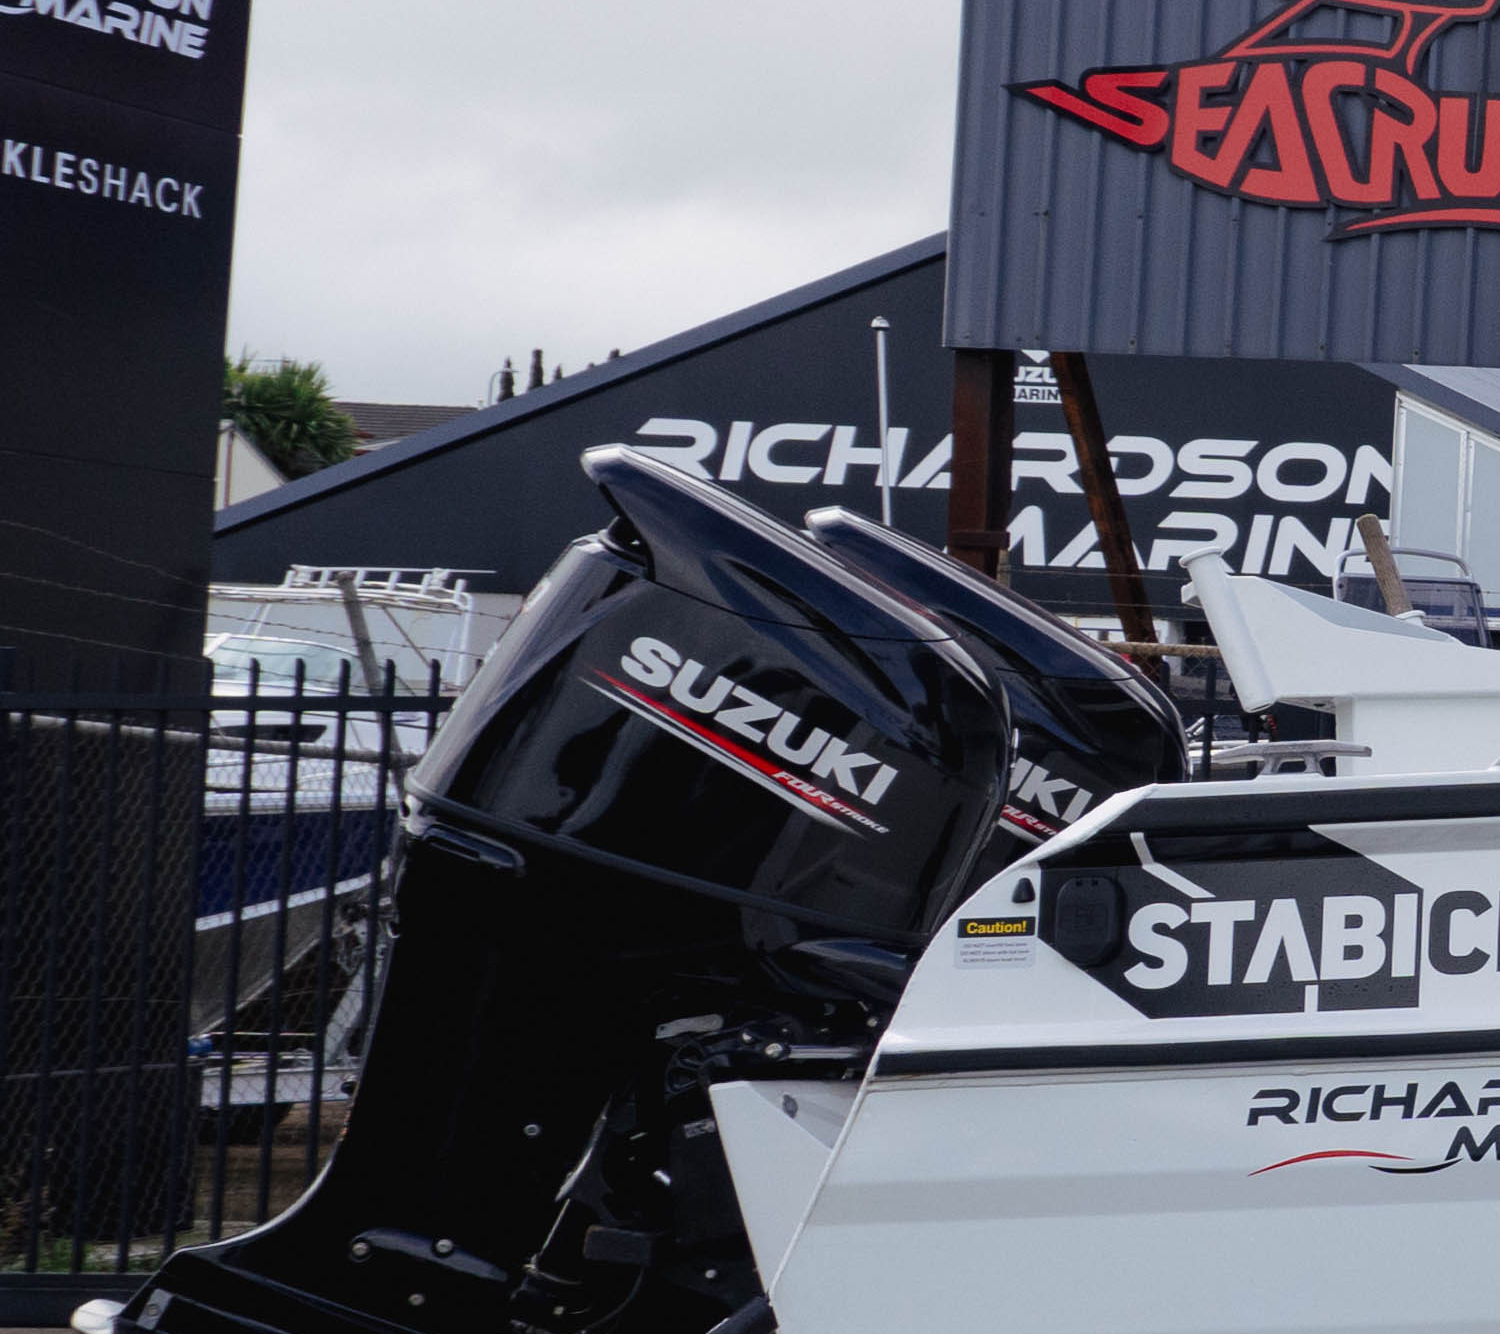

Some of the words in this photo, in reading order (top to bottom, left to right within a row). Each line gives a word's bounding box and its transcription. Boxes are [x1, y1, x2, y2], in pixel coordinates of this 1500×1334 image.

[2, 139, 204, 219] KLESHACK
[621, 636, 898, 805] SUZUKI
[966, 920, 1027, 934] Caution!
